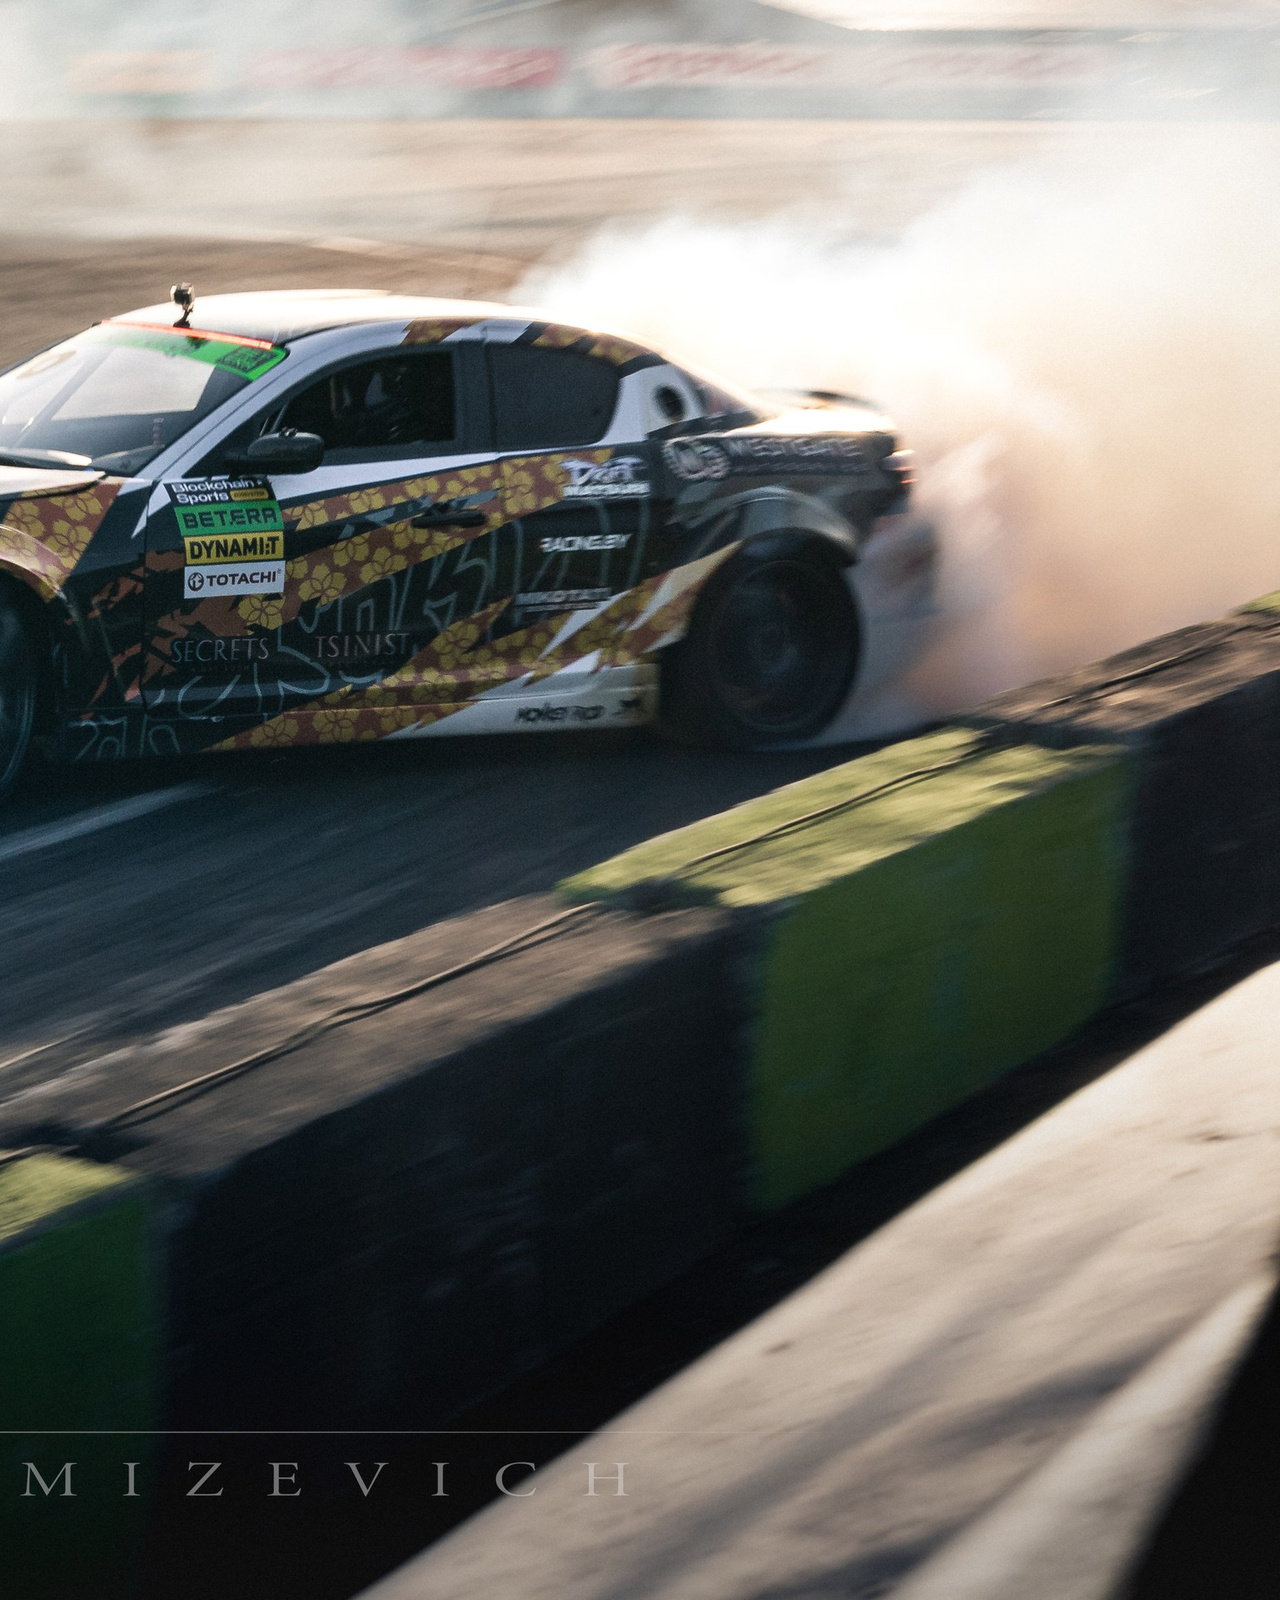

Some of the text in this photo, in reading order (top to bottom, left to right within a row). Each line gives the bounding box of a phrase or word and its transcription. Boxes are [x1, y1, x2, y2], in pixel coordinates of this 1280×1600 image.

[172, 479, 254, 493] Blockchain
[176, 491, 229, 505] Sports
[206, 571, 277, 587] TOTACHI
[172, 637, 269, 663] SECRETS
